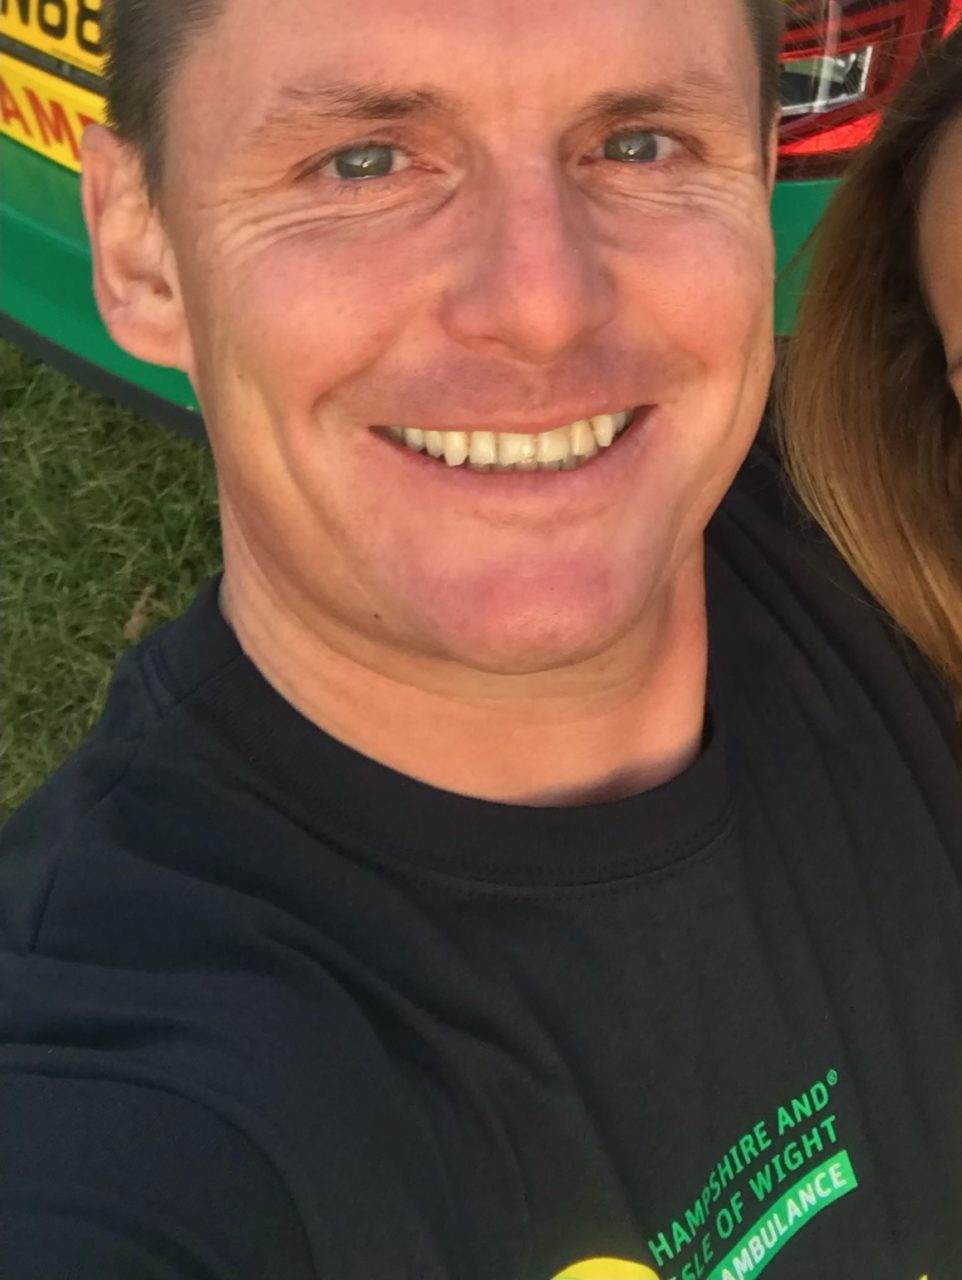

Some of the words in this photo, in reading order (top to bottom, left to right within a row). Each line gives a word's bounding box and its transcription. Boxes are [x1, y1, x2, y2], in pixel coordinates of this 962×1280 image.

[0, 75, 98, 162] AM
[648, 1121, 772, 1267] HAMPSHIRE
[668, 1233, 714, 1280] SLE
[716, 1191, 744, 1239] OF
[748, 1115, 837, 1201] WIGHT
